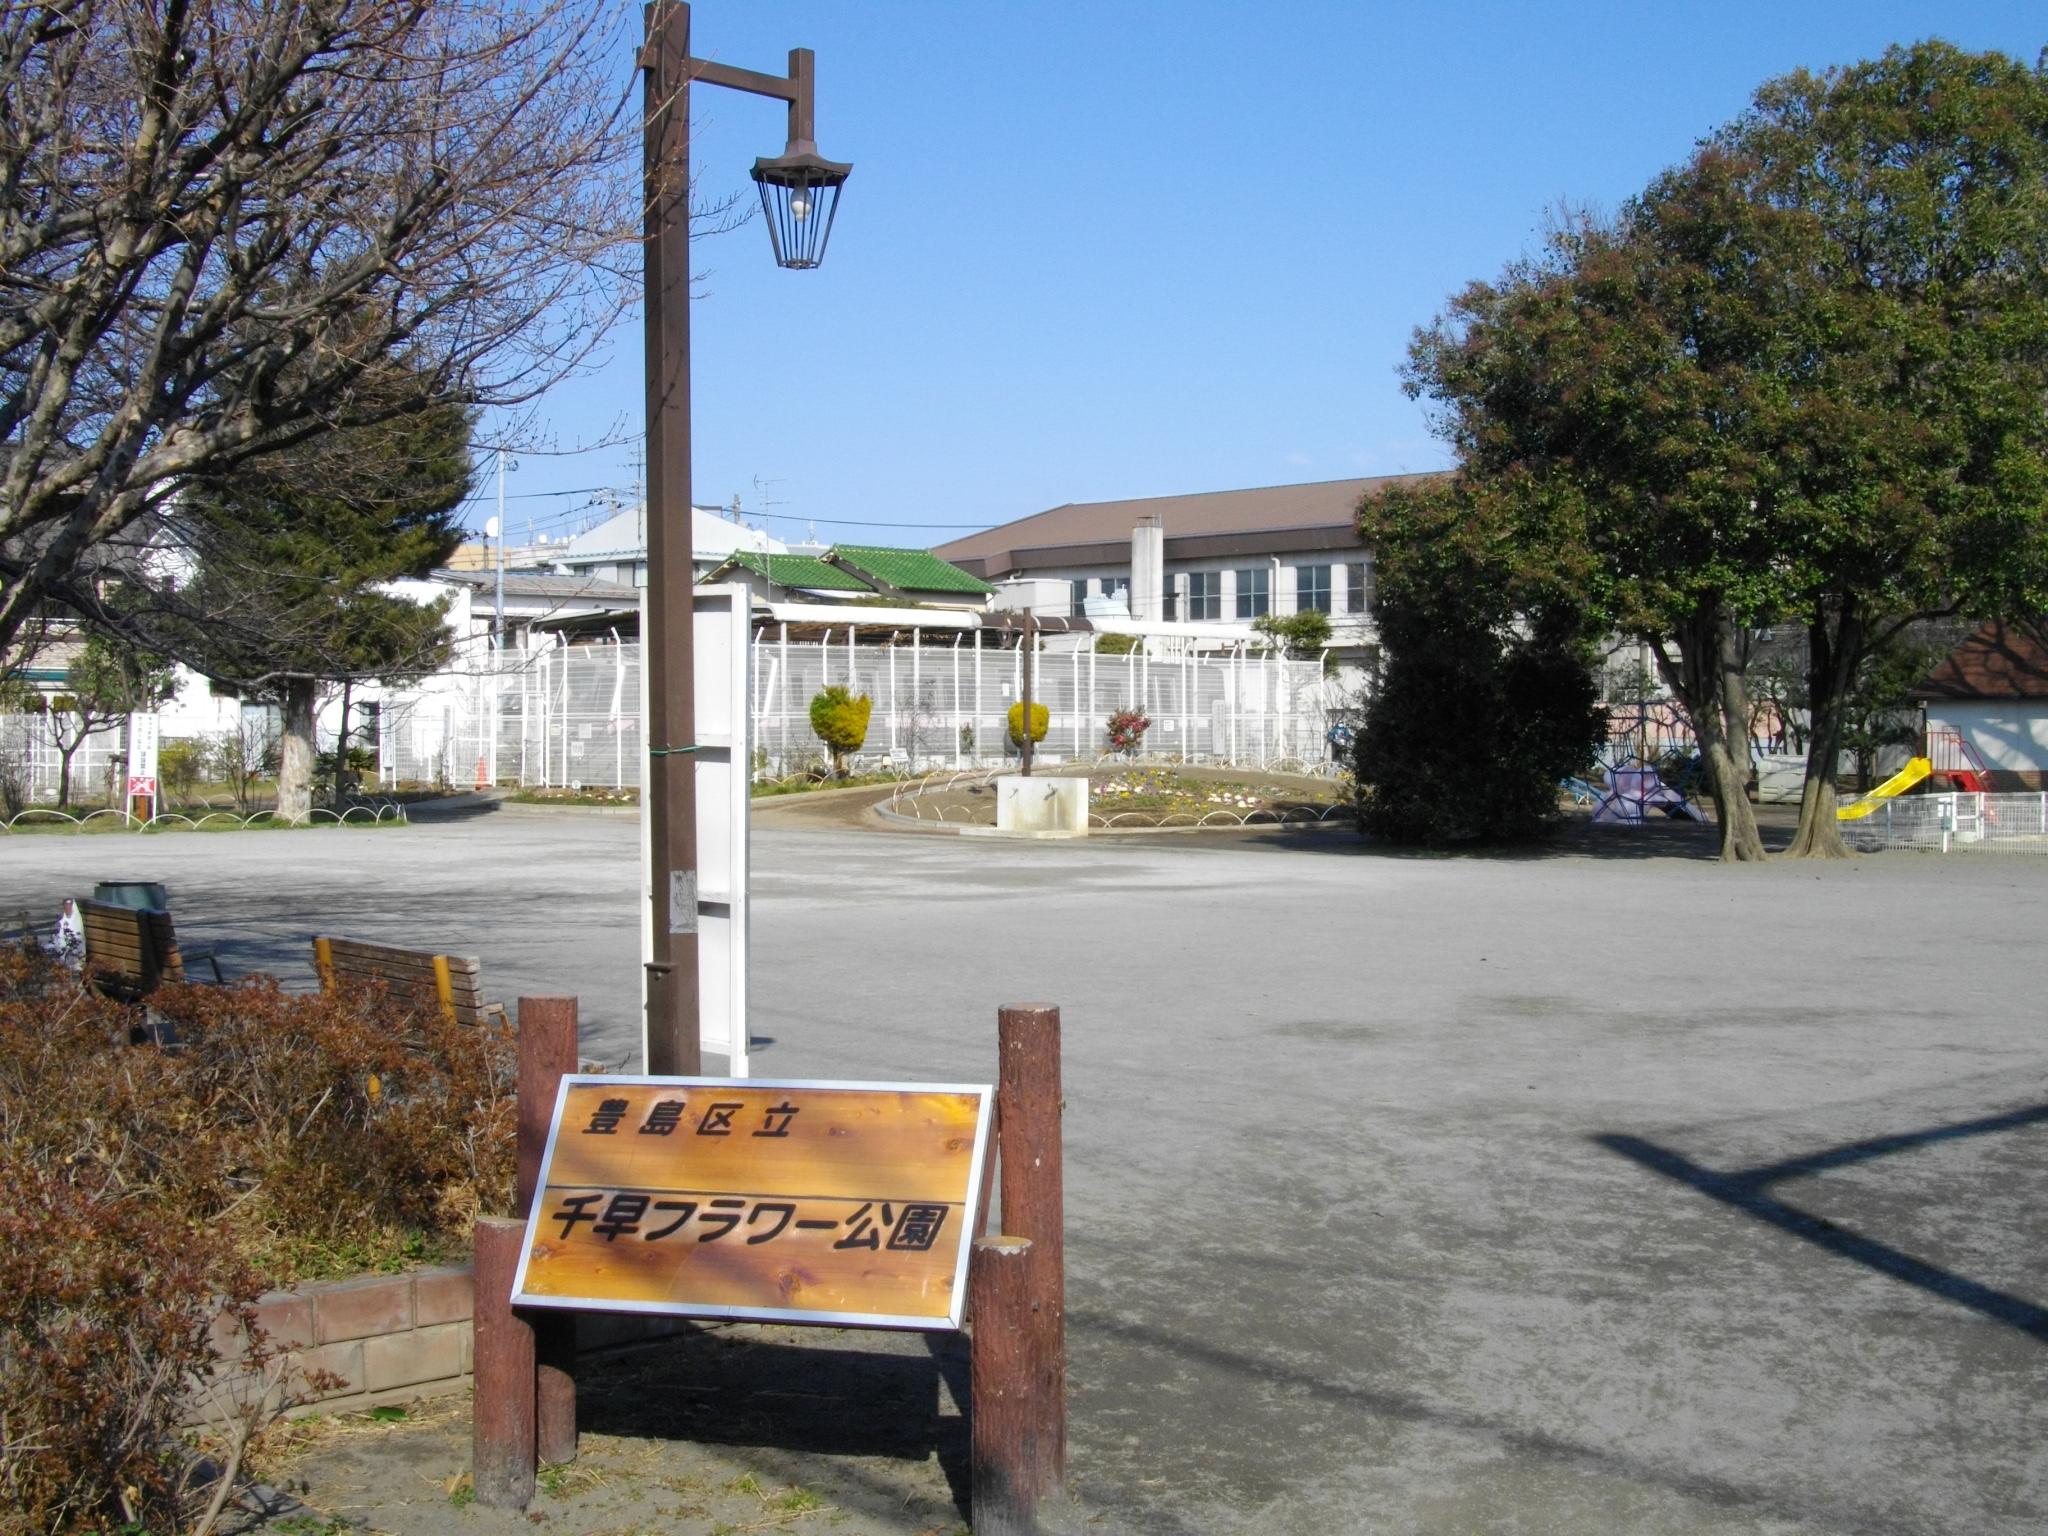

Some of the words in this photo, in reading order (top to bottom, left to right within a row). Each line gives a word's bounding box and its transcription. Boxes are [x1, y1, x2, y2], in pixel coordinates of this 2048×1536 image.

[582, 1099, 800, 1138] 豊島区立
[552, 1194, 949, 1251] 千早フラワー公園
